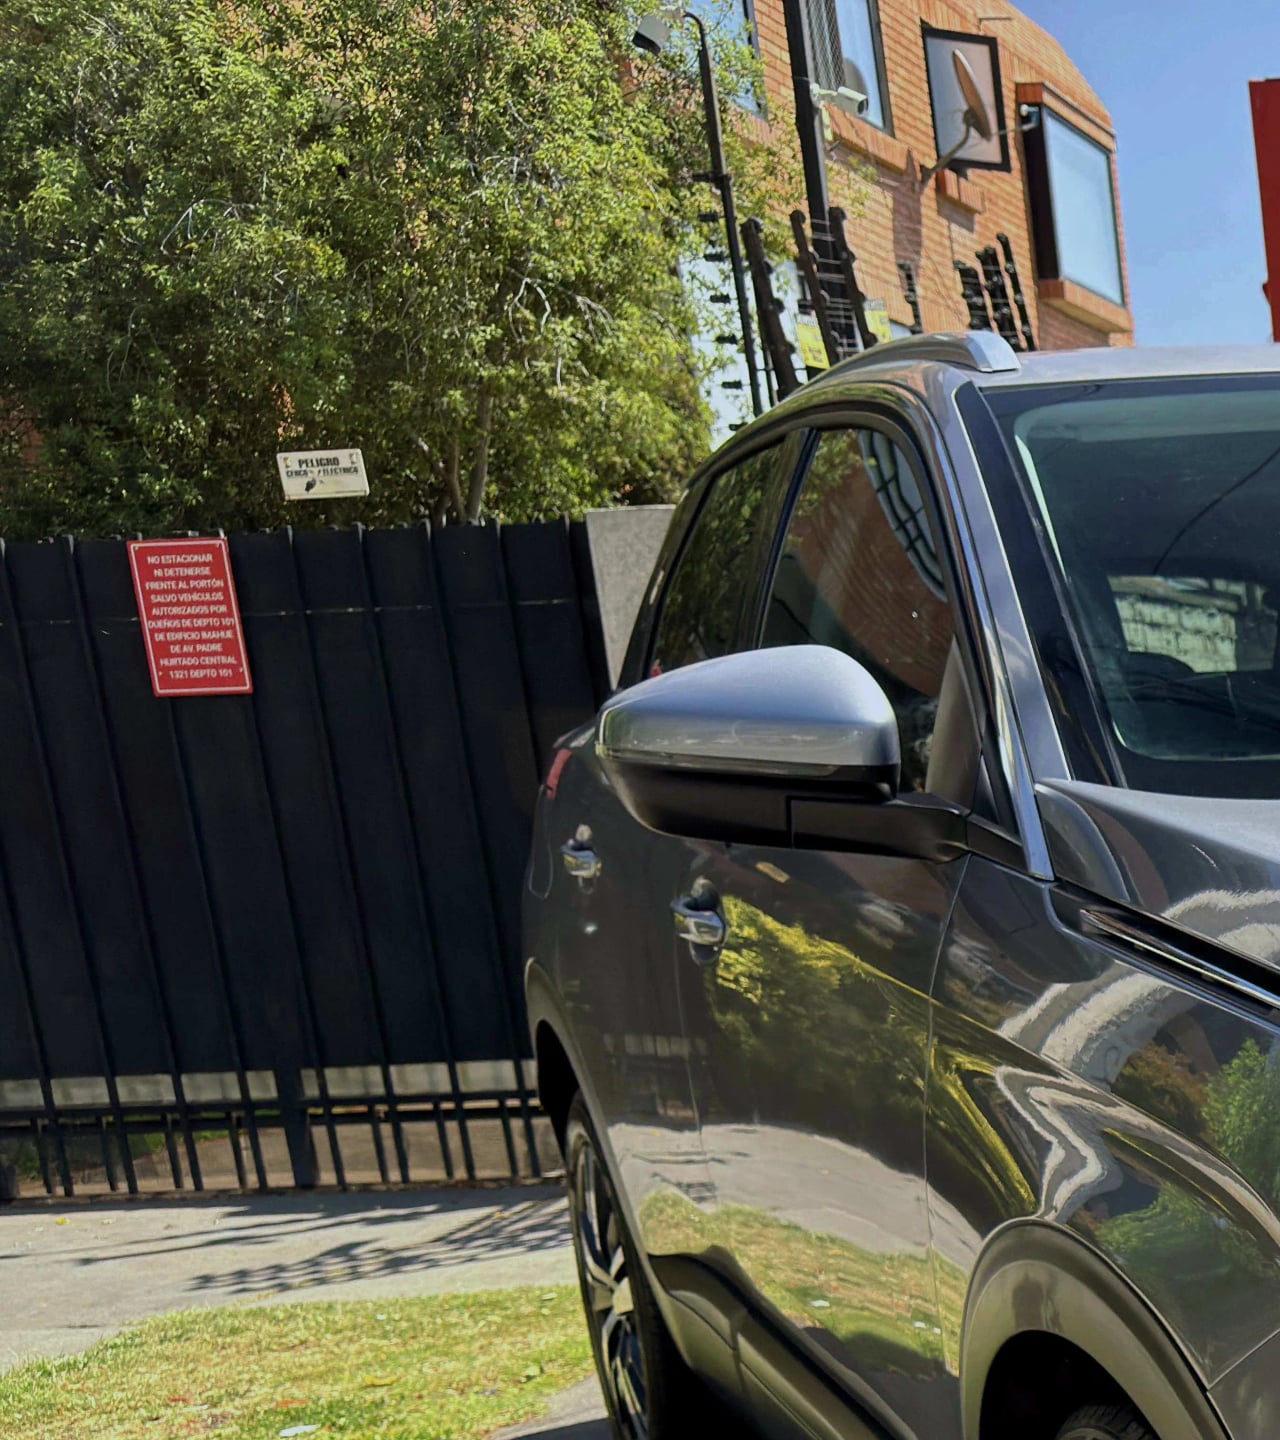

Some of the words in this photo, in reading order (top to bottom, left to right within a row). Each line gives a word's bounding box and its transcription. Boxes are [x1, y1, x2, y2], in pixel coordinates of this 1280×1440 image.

[298, 457, 340, 469] PELIGRO
[147, 555, 160, 565] NO
[161, 553, 213, 564] ESTACIONAR
[153, 568, 163, 577] NI
[164, 566, 211, 577] DETENERSE
[145, 580, 176, 590] FRENTE
[178, 580, 189, 589] AL
[151, 594, 177, 603] SALVO
[152, 605, 209, 615] AUTORIZADOS
[210, 604, 227, 614] POR
[181, 618, 192, 628] DE
[193, 618, 220, 628] DEPTO
[221, 617, 235, 626] 101
[154, 632, 165, 642] DE
[166, 631, 200, 641] EDIFICIO
[170, 644, 181, 654] DE
[196, 643, 223, 652] PADRE
[160, 656, 199, 666] HURTADO
[200, 655, 237, 665] CENTRAL
[189, 668, 217, 678] DEPTO
